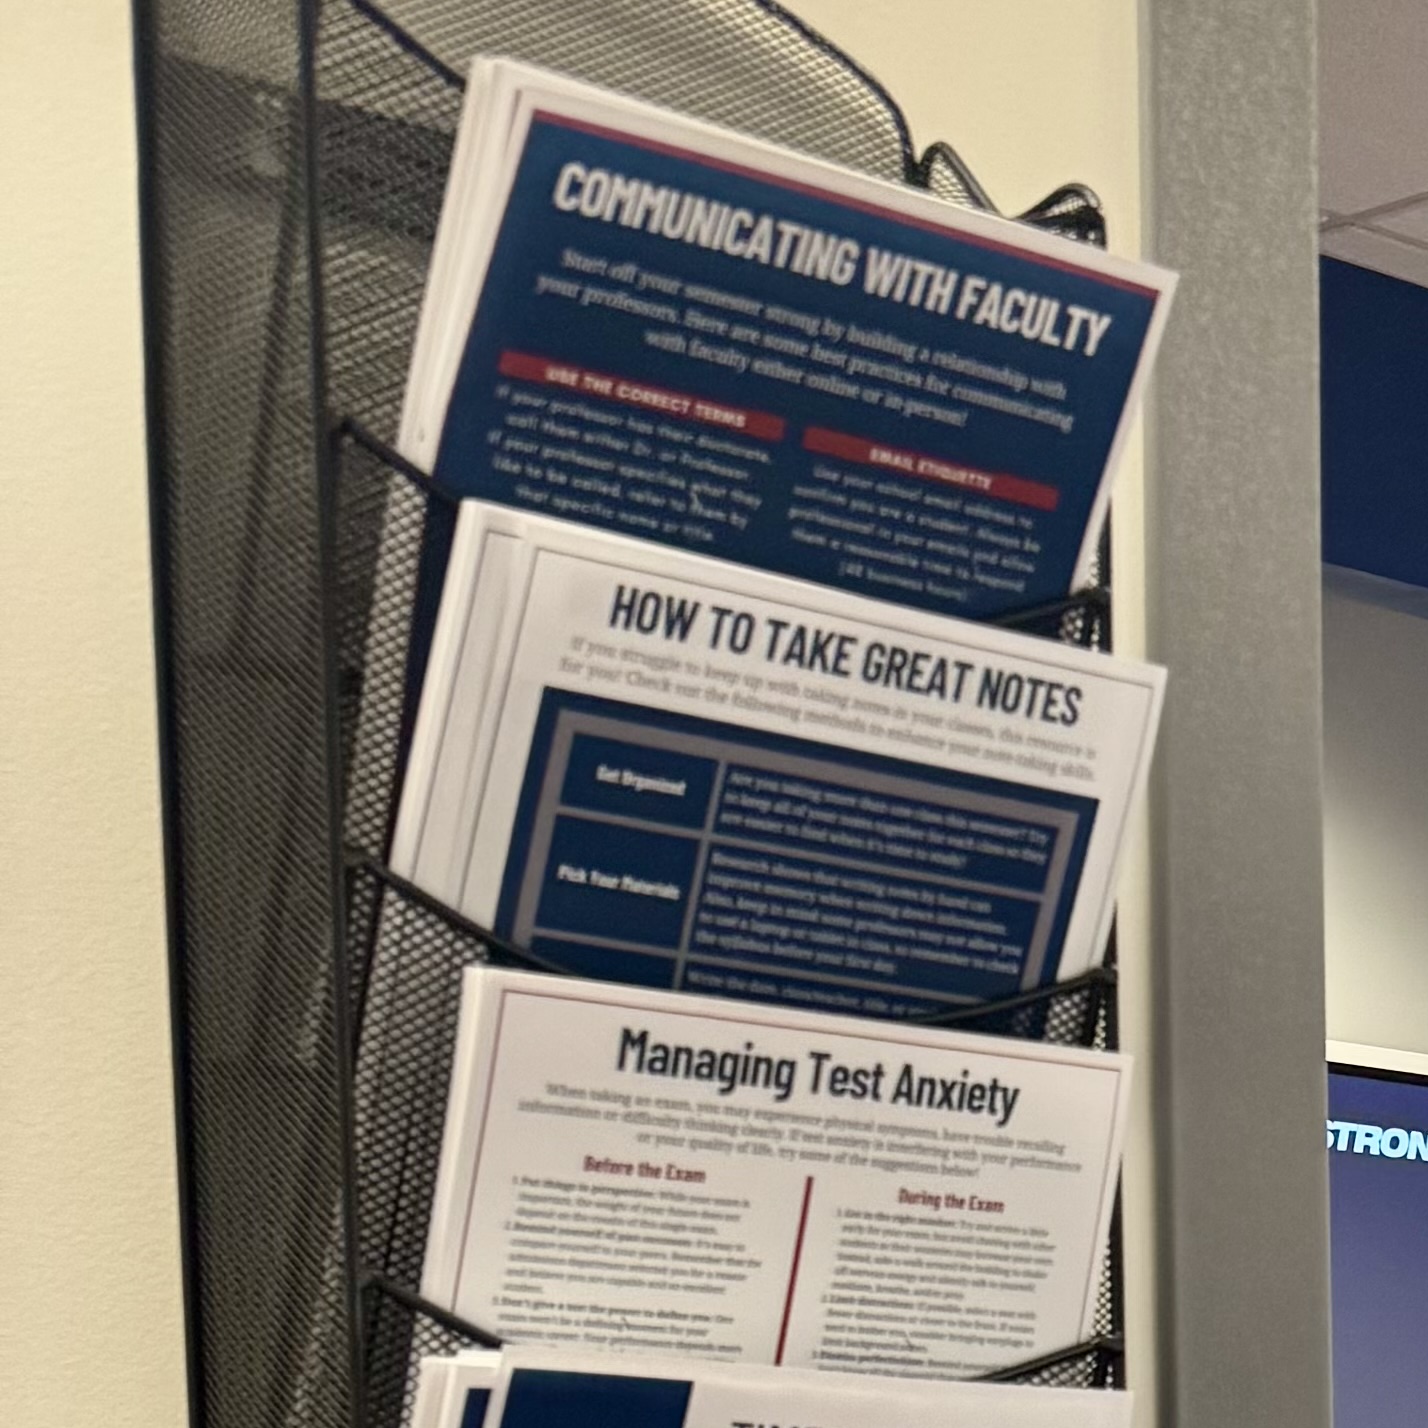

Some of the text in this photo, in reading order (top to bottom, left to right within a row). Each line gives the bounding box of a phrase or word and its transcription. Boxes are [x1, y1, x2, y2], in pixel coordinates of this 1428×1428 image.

[550, 161, 1114, 357] COMMUNICATING WITH FACULTY
[534, 274, 580, 298] your
[681, 310, 729, 338] Here
[728, 326, 760, 346] are
[759, 334, 810, 359] some
[809, 344, 848, 369] best
[845, 357, 923, 389] practices
[922, 374, 950, 396] for
[949, 384, 1074, 434] communicating
[561, 247, 1069, 400] Start off your semester strong by building a relationship with
[642, 329, 689, 354] with
[686, 338, 750, 375] faculty
[749, 356, 803, 384] either
[805, 373, 861, 399] online
[860, 387, 883, 405] or
[543, 365, 748, 428] USE THE CORRECT TERMS
[868, 446, 993, 491] EMAIL ETIQUETTE
[607, 585, 1085, 729] HOW TO TAKE GREAT NOTES
[614, 1028, 1021, 1129] Managing Test Anxiety
[582, 1154, 706, 1183] Before the Exam
[897, 1188, 1005, 1213] During the Exam
